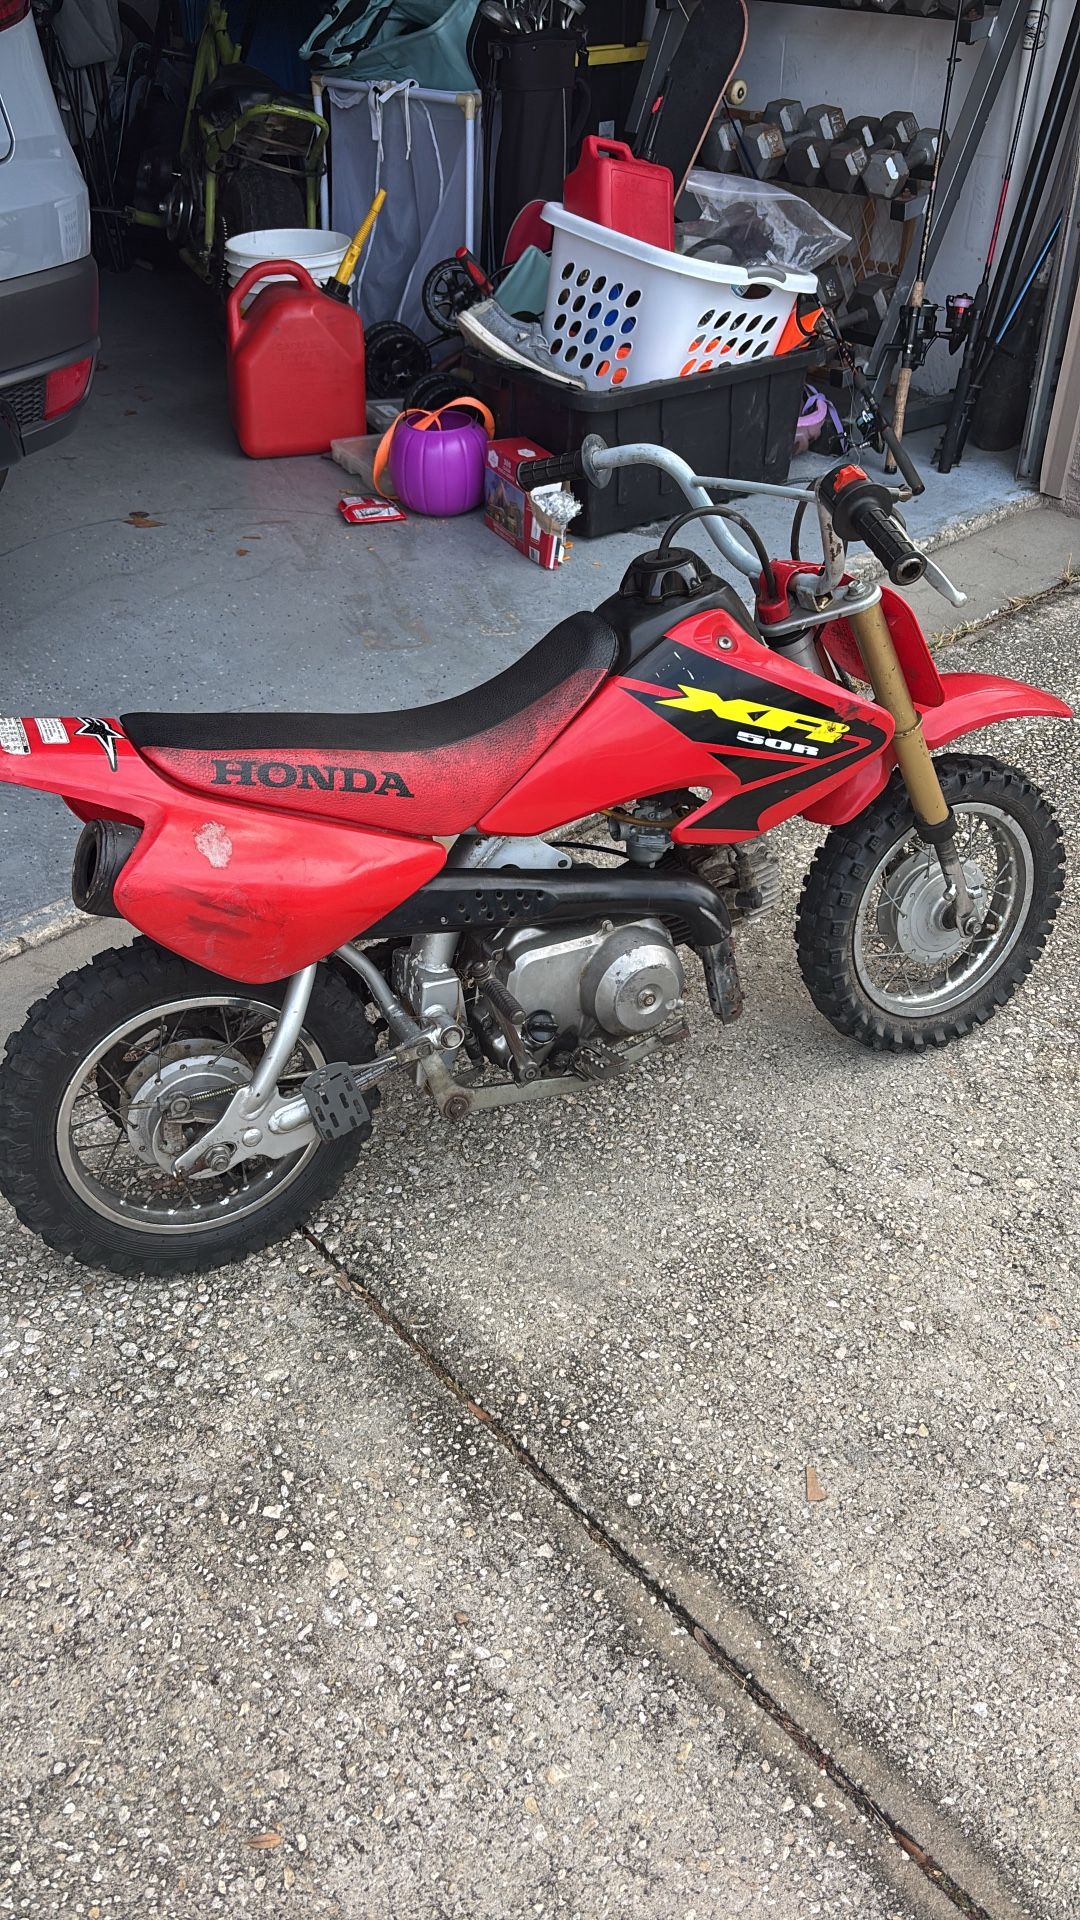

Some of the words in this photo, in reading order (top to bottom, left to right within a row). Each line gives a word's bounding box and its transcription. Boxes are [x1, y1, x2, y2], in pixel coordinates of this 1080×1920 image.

[655, 684, 850, 743] XR
[736, 731, 819, 756] 50R
[211, 759, 415, 798] HONDA
